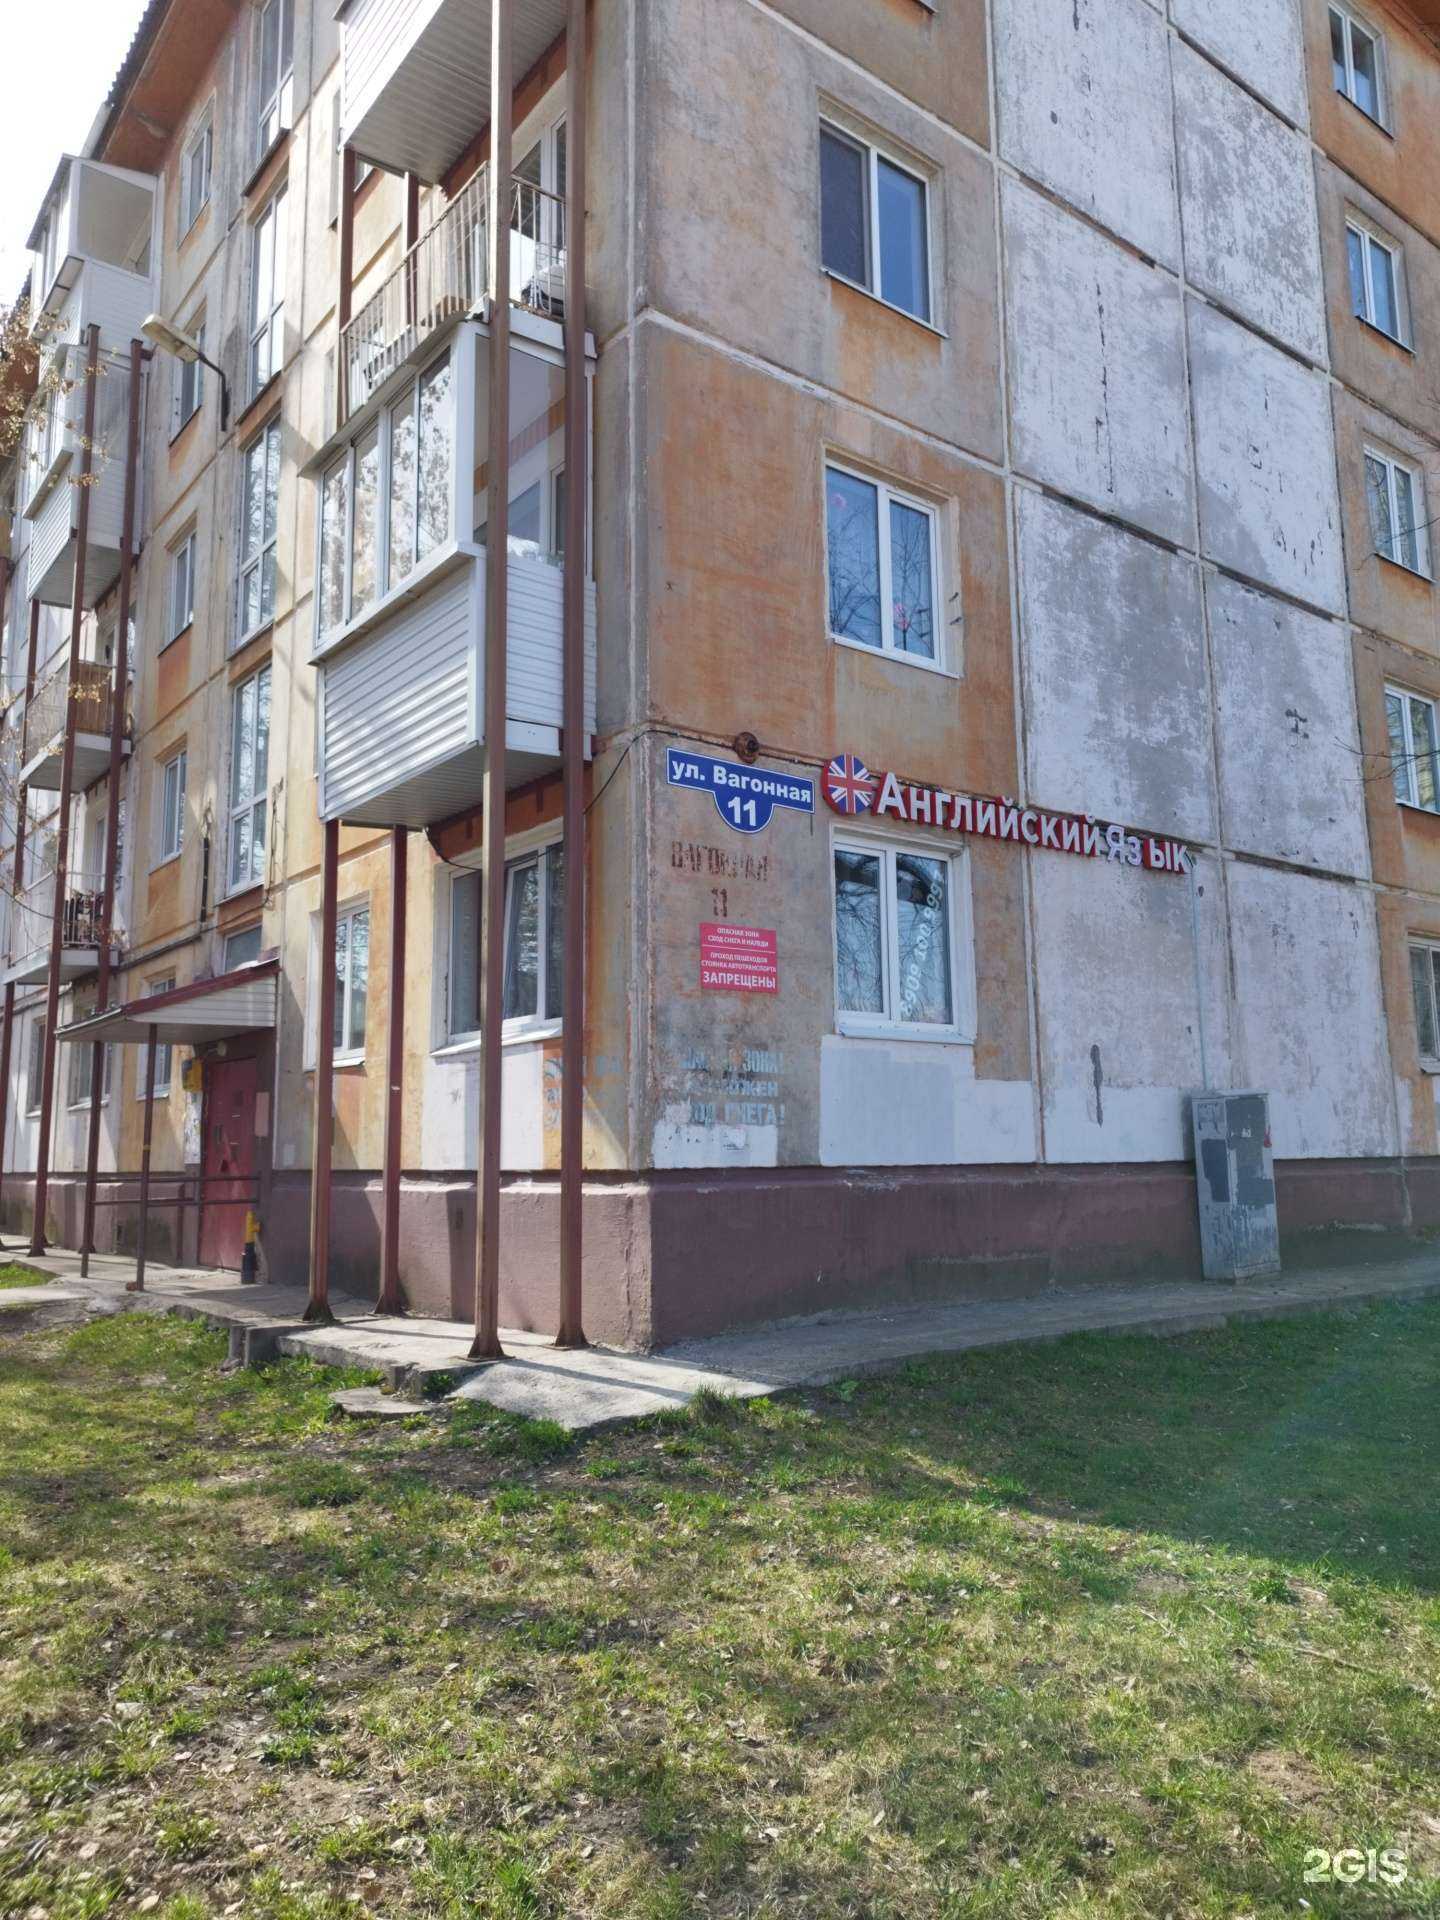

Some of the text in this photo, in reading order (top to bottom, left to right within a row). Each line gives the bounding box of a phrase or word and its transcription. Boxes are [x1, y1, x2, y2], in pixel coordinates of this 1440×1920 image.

[672, 760, 811, 803] ул. Вагонная
[728, 797, 756, 826] 11
[703, 971, 776, 989] ЗАПРЕЩЕНЫ
